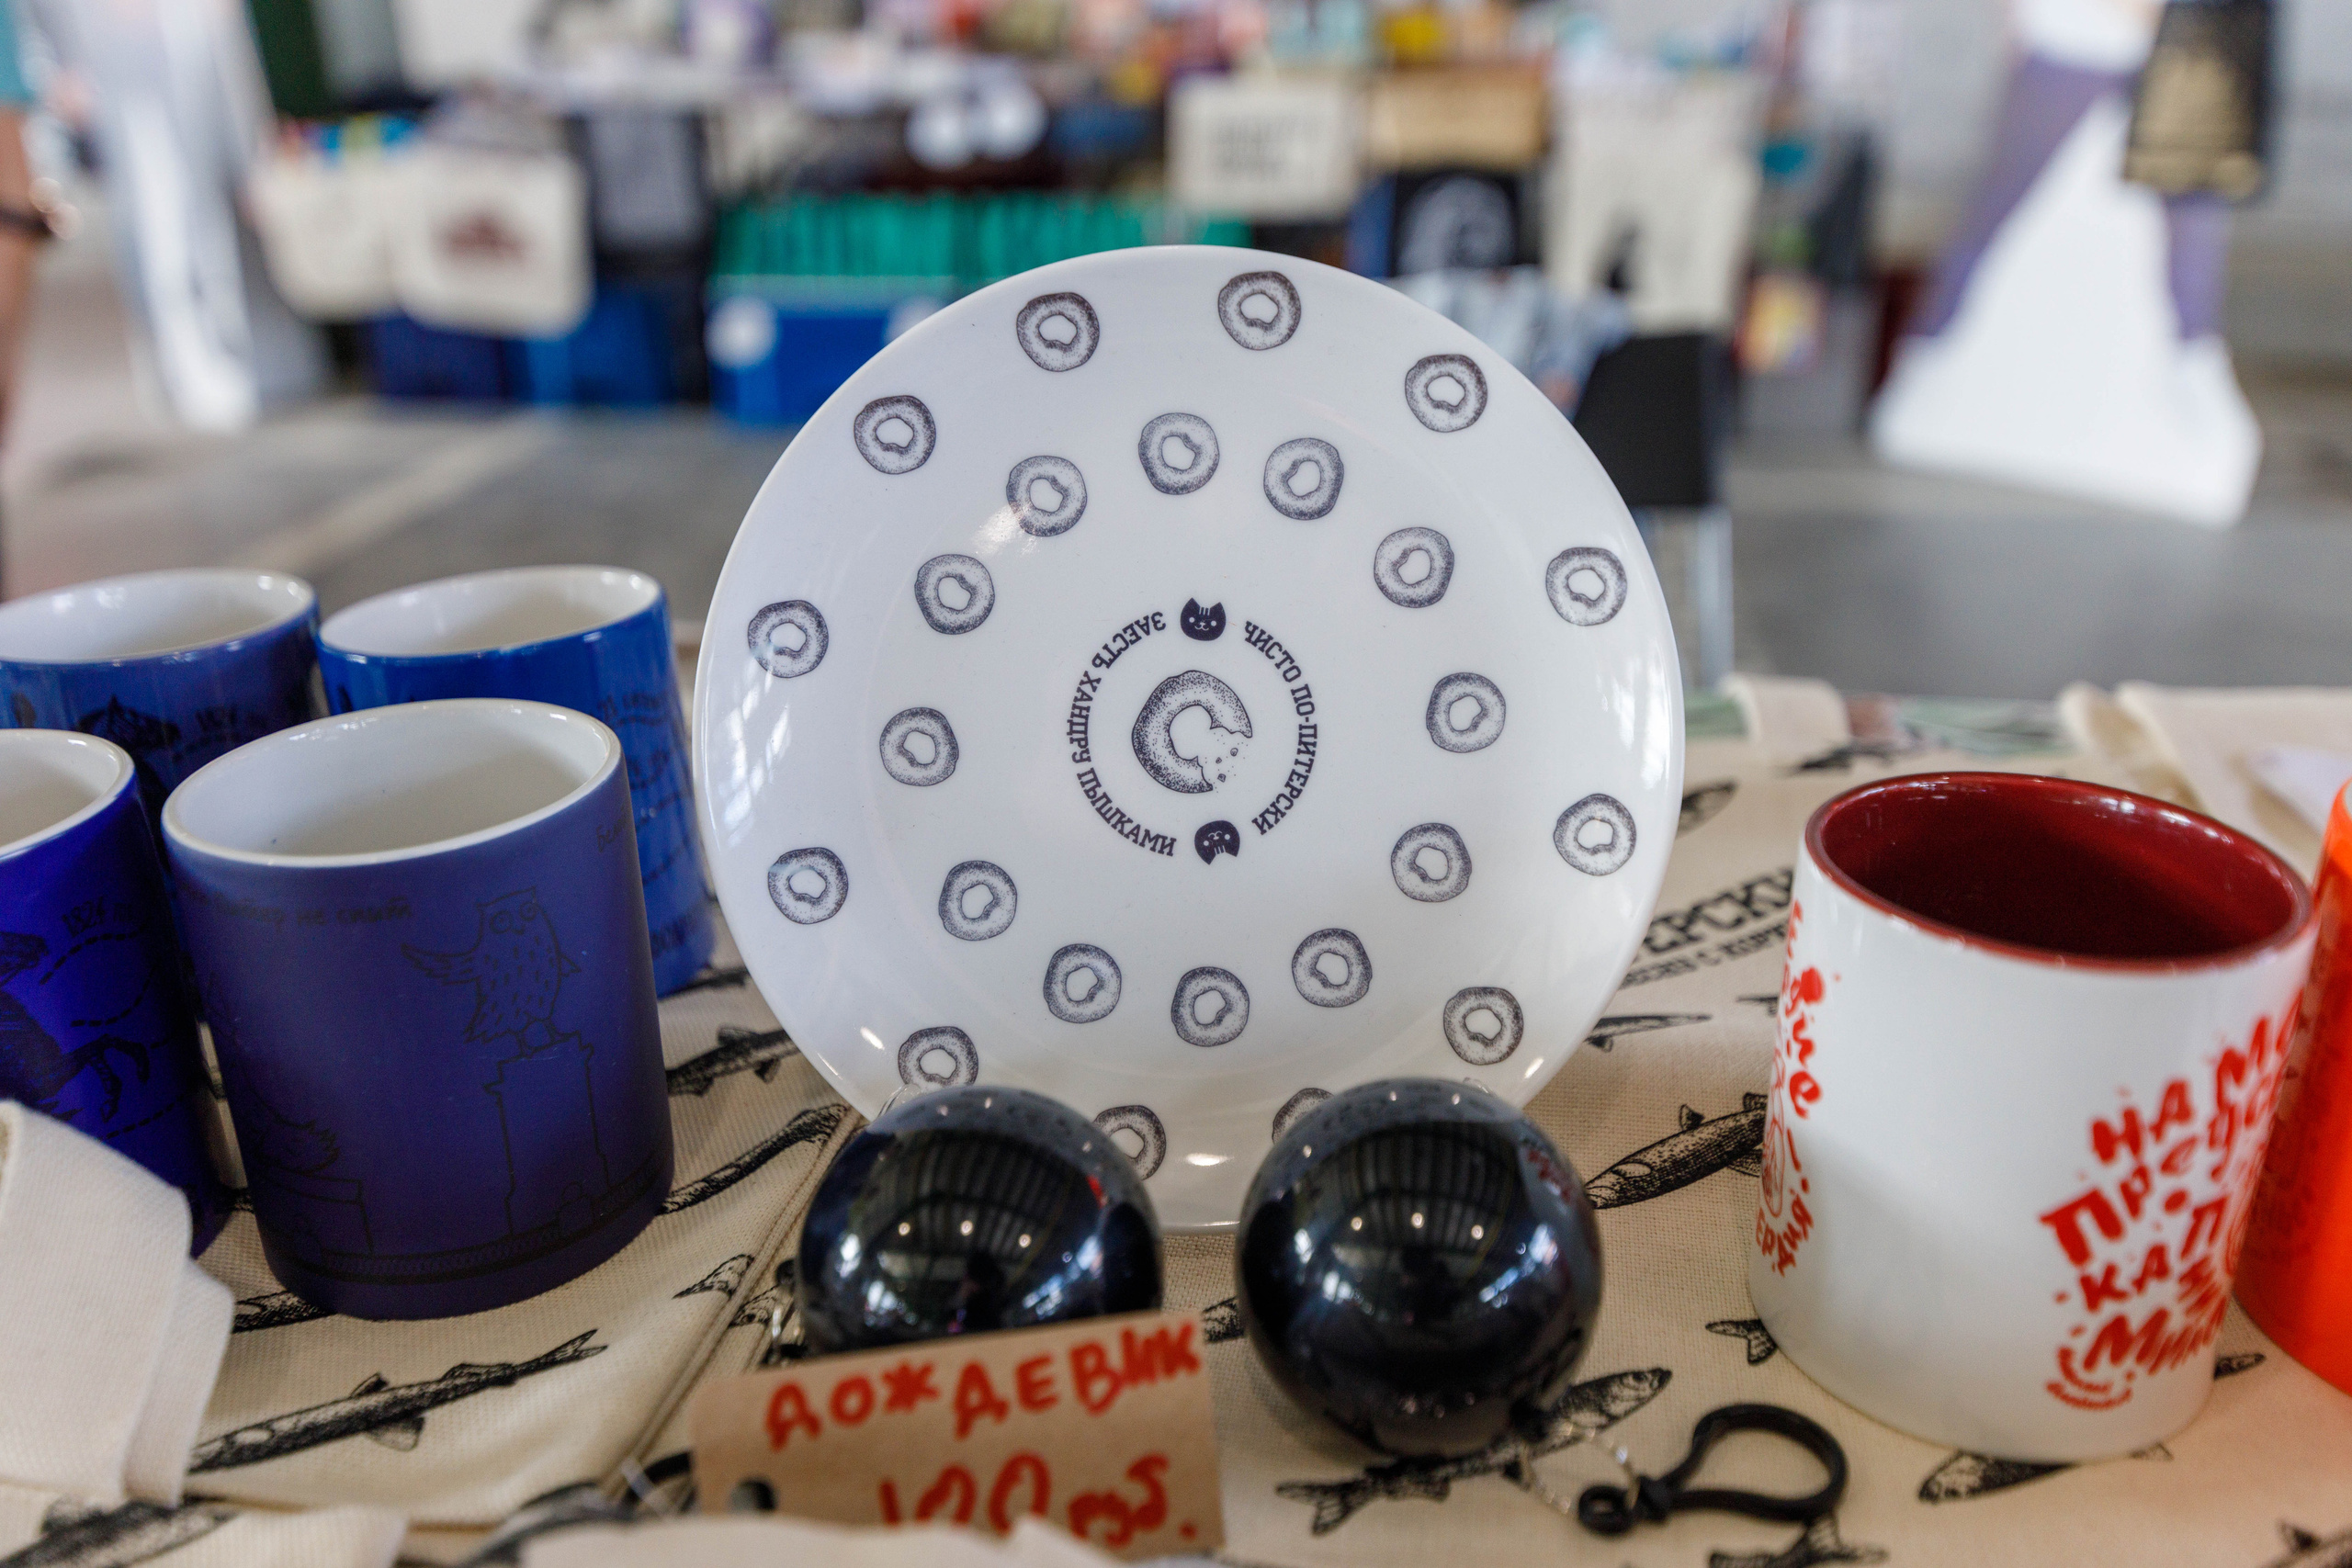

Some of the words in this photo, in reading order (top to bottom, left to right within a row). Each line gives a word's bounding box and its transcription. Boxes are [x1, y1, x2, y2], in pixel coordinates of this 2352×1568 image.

[1091, 612, 1166, 669] ЗАЕСТЬ
[1244, 620, 1302, 683] ЧИСТО
[1067, 671, 1102, 764] ХАНДРУ
[1251, 683, 1317, 836] ПО-ПИТЕРСКИ
[1077, 767, 1177, 857] ПЫШКАМИ
[1641, 866, 1793, 957] ЕРСКУ
[764, 1318, 1200, 1453] ДОЖДЕВИК
